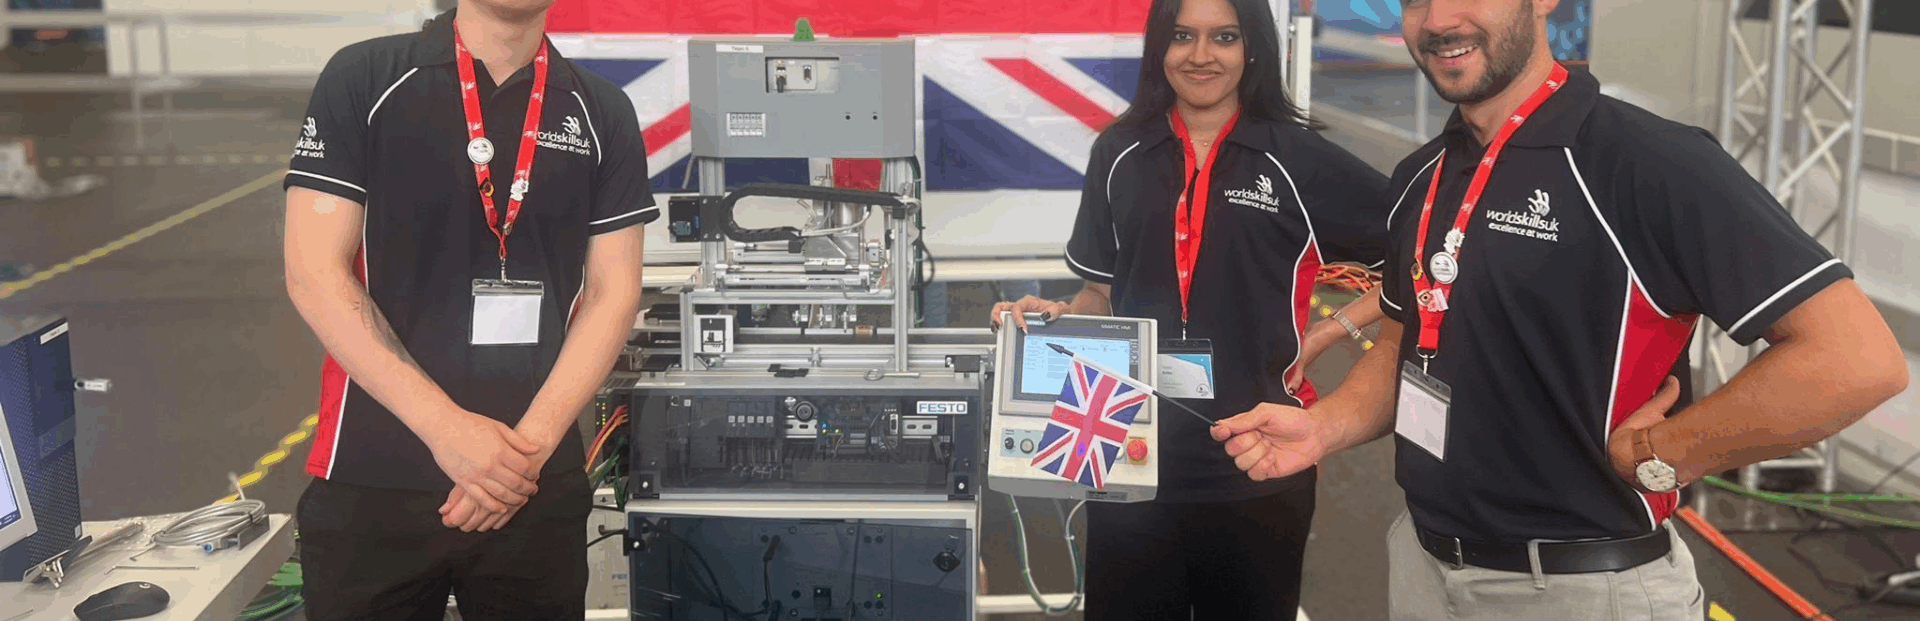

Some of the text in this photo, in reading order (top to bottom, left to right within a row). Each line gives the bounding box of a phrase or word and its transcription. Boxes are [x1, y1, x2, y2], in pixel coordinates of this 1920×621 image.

[537, 131, 590, 148] orldskillsuk
[309, 151, 325, 159] work
[575, 148, 590, 156] work
[1224, 188, 1280, 207] worldskillsuk
[1228, 197, 1260, 209] excellence
[1267, 205, 1279, 214] work
[1486, 209, 1560, 232] worldskillsuk
[1488, 222, 1559, 242] excellence at work
[919, 403, 966, 413] FESTO
